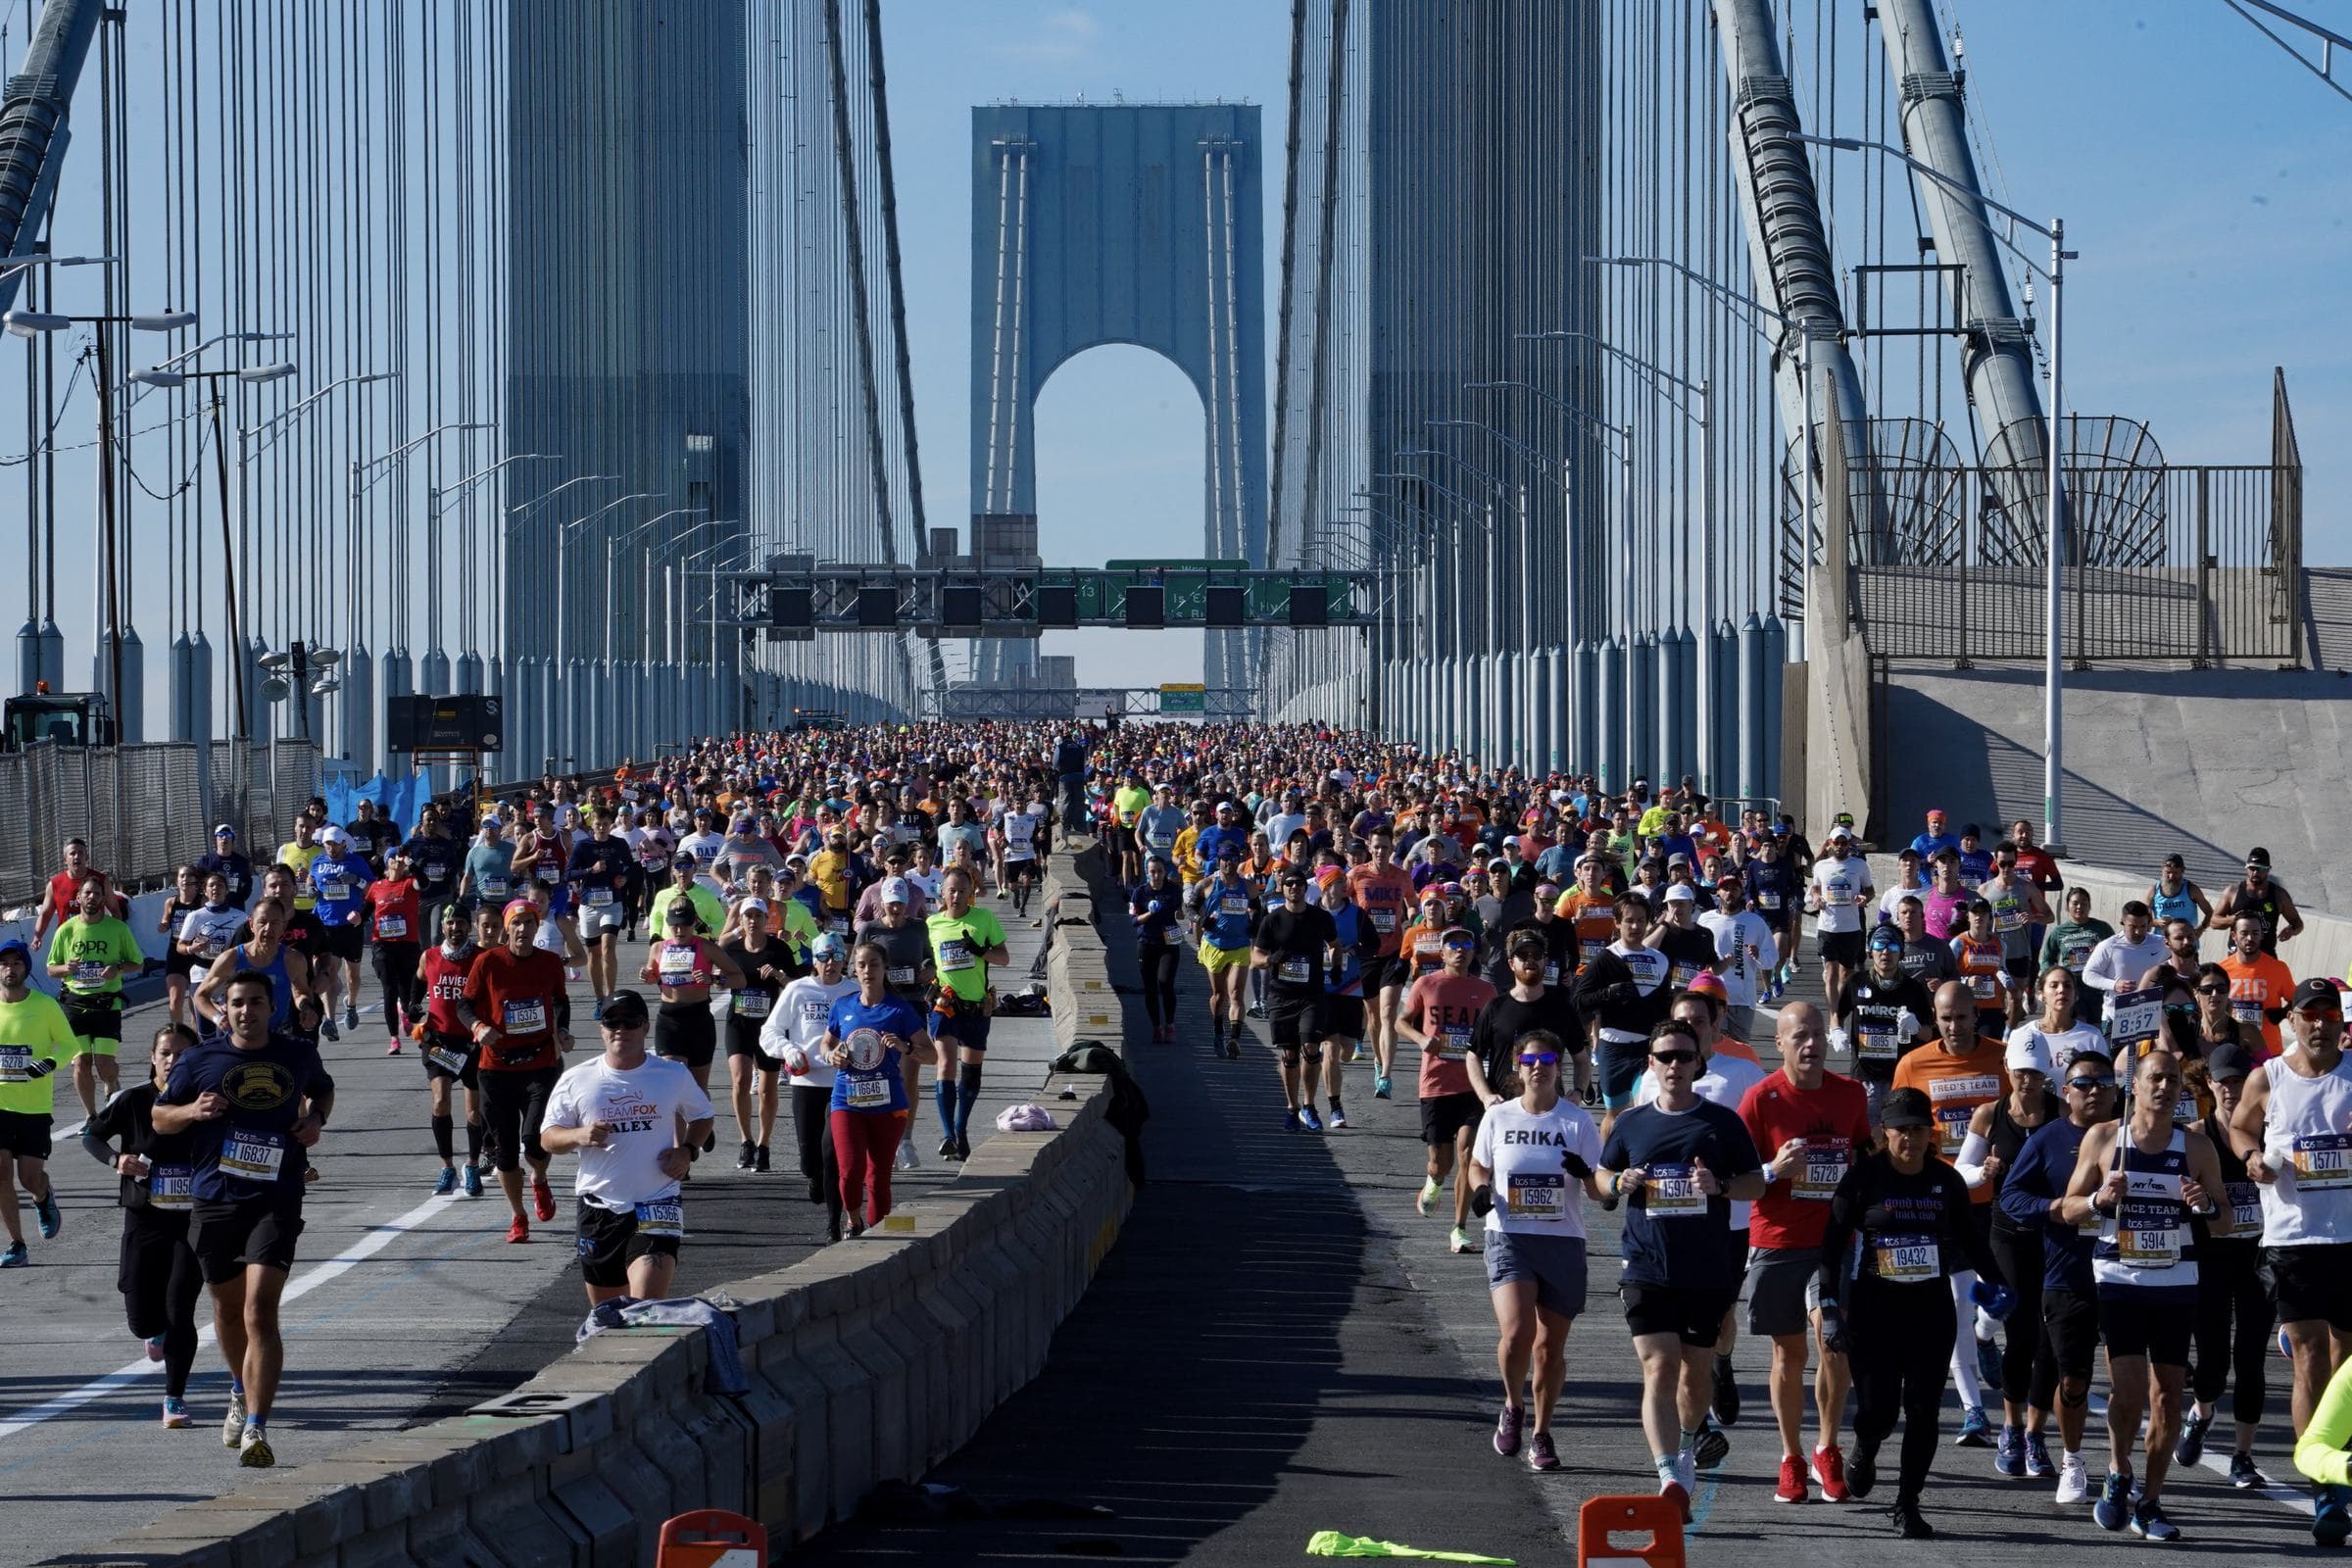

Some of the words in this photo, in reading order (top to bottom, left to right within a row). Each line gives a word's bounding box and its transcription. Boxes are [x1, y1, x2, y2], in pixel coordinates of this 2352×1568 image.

[696, 846, 717, 858] DAN
[1364, 886, 1401, 902] MIKE
[432, 986, 462, 1001] PER
[2229, 978, 2268, 1002] ZIG
[517, 1008, 538, 1022] 15375
[805, 1012, 829, 1021] BRAN
[2120, 1013, 2153, 1034] 8:57
[1933, 1081, 1966, 1093] FRED'S
[1970, 1080, 1997, 1090] TEAM
[610, 1119, 653, 1134] ALEX
[1504, 1129, 1567, 1148] ERIKA
[239, 1143, 271, 1164] 16837
[2314, 1151, 2342, 1170] 15771
[1810, 1165, 1838, 1182] 15728
[1524, 1188, 1552, 1205] 15962
[1663, 1179, 1692, 1198] 15974
[653, 1205, 679, 1222] 15366
[2119, 1203, 2146, 1214] PACE
[2148, 1204, 2180, 1216] TEAM
[2234, 1205, 2255, 1224] 722
[2141, 1232, 2166, 1250] 5914
[1896, 1247, 1928, 1266] 19432
